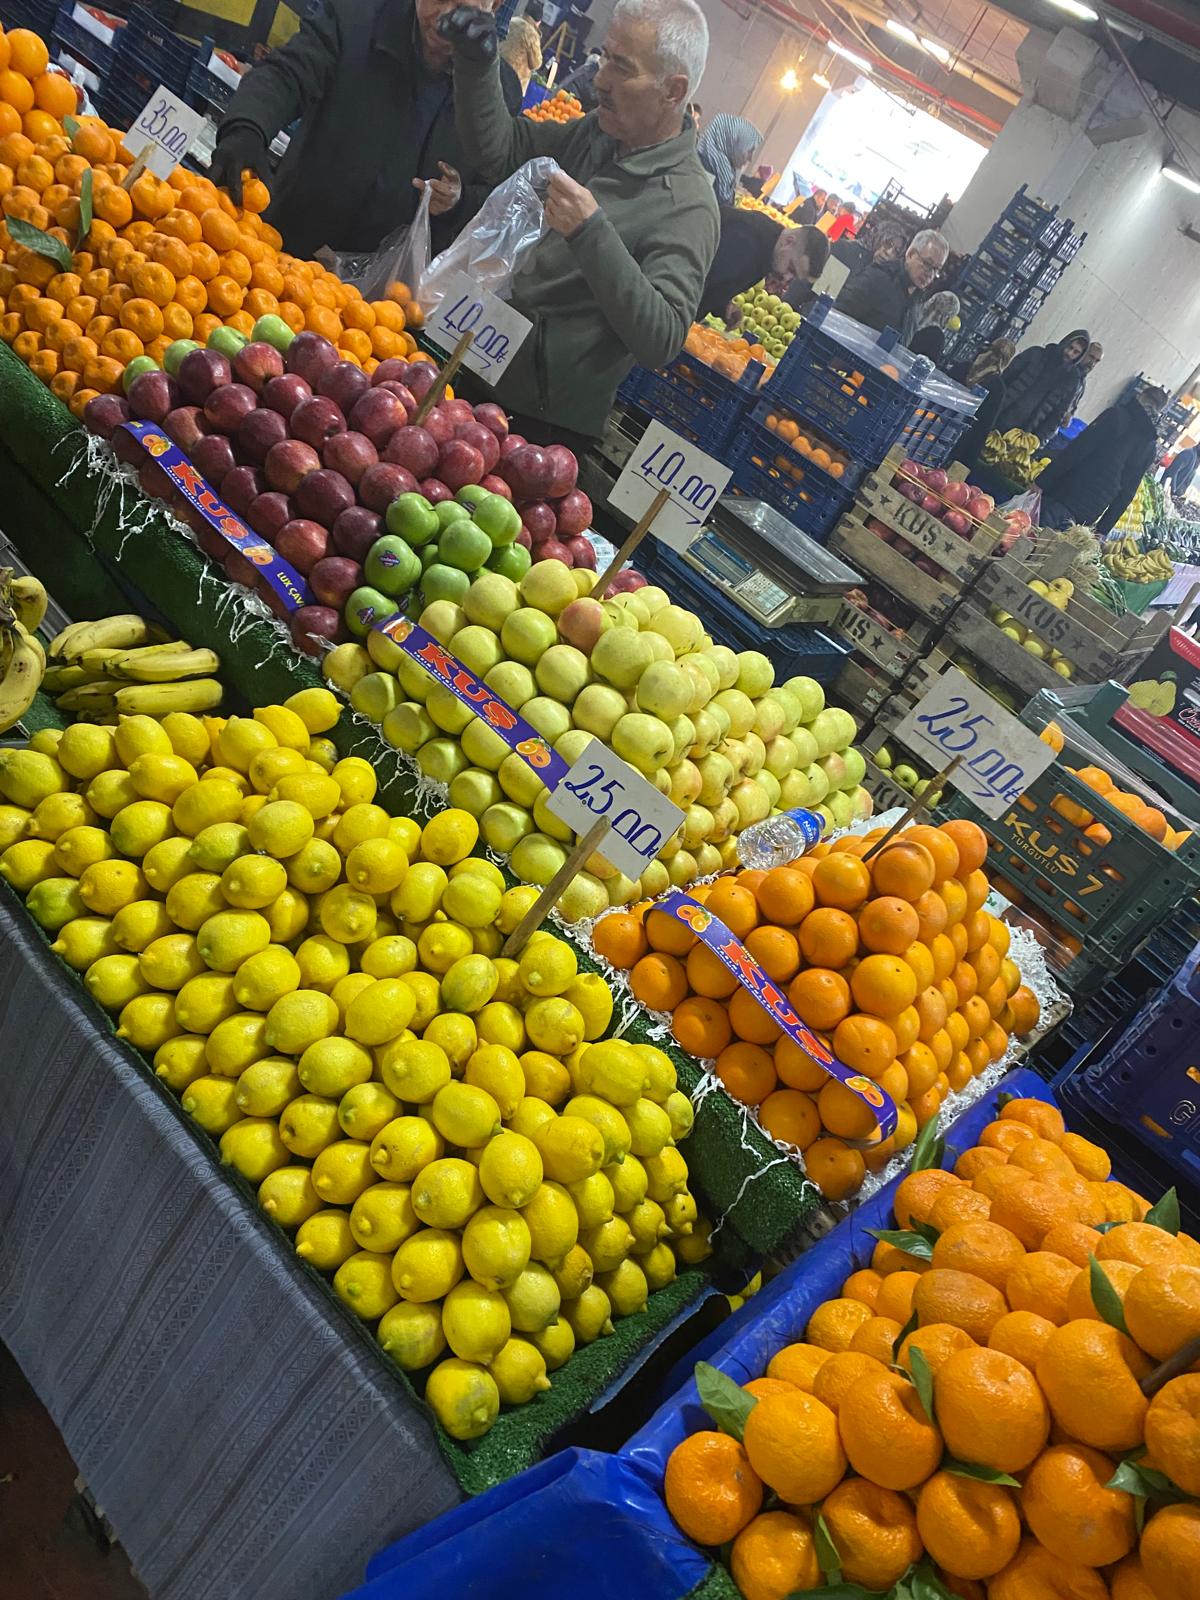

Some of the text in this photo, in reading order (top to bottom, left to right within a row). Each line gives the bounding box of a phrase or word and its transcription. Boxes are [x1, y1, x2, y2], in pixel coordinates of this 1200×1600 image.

[641, 443, 717, 511] 40.00
[276, 571, 294, 588] LUX
[840, 603, 871, 641] UŞ
[1017, 594, 1071, 642] KUŞ
[1010, 833, 1059, 874] TURGUTLU
[1078, 873, 1104, 896] 7
